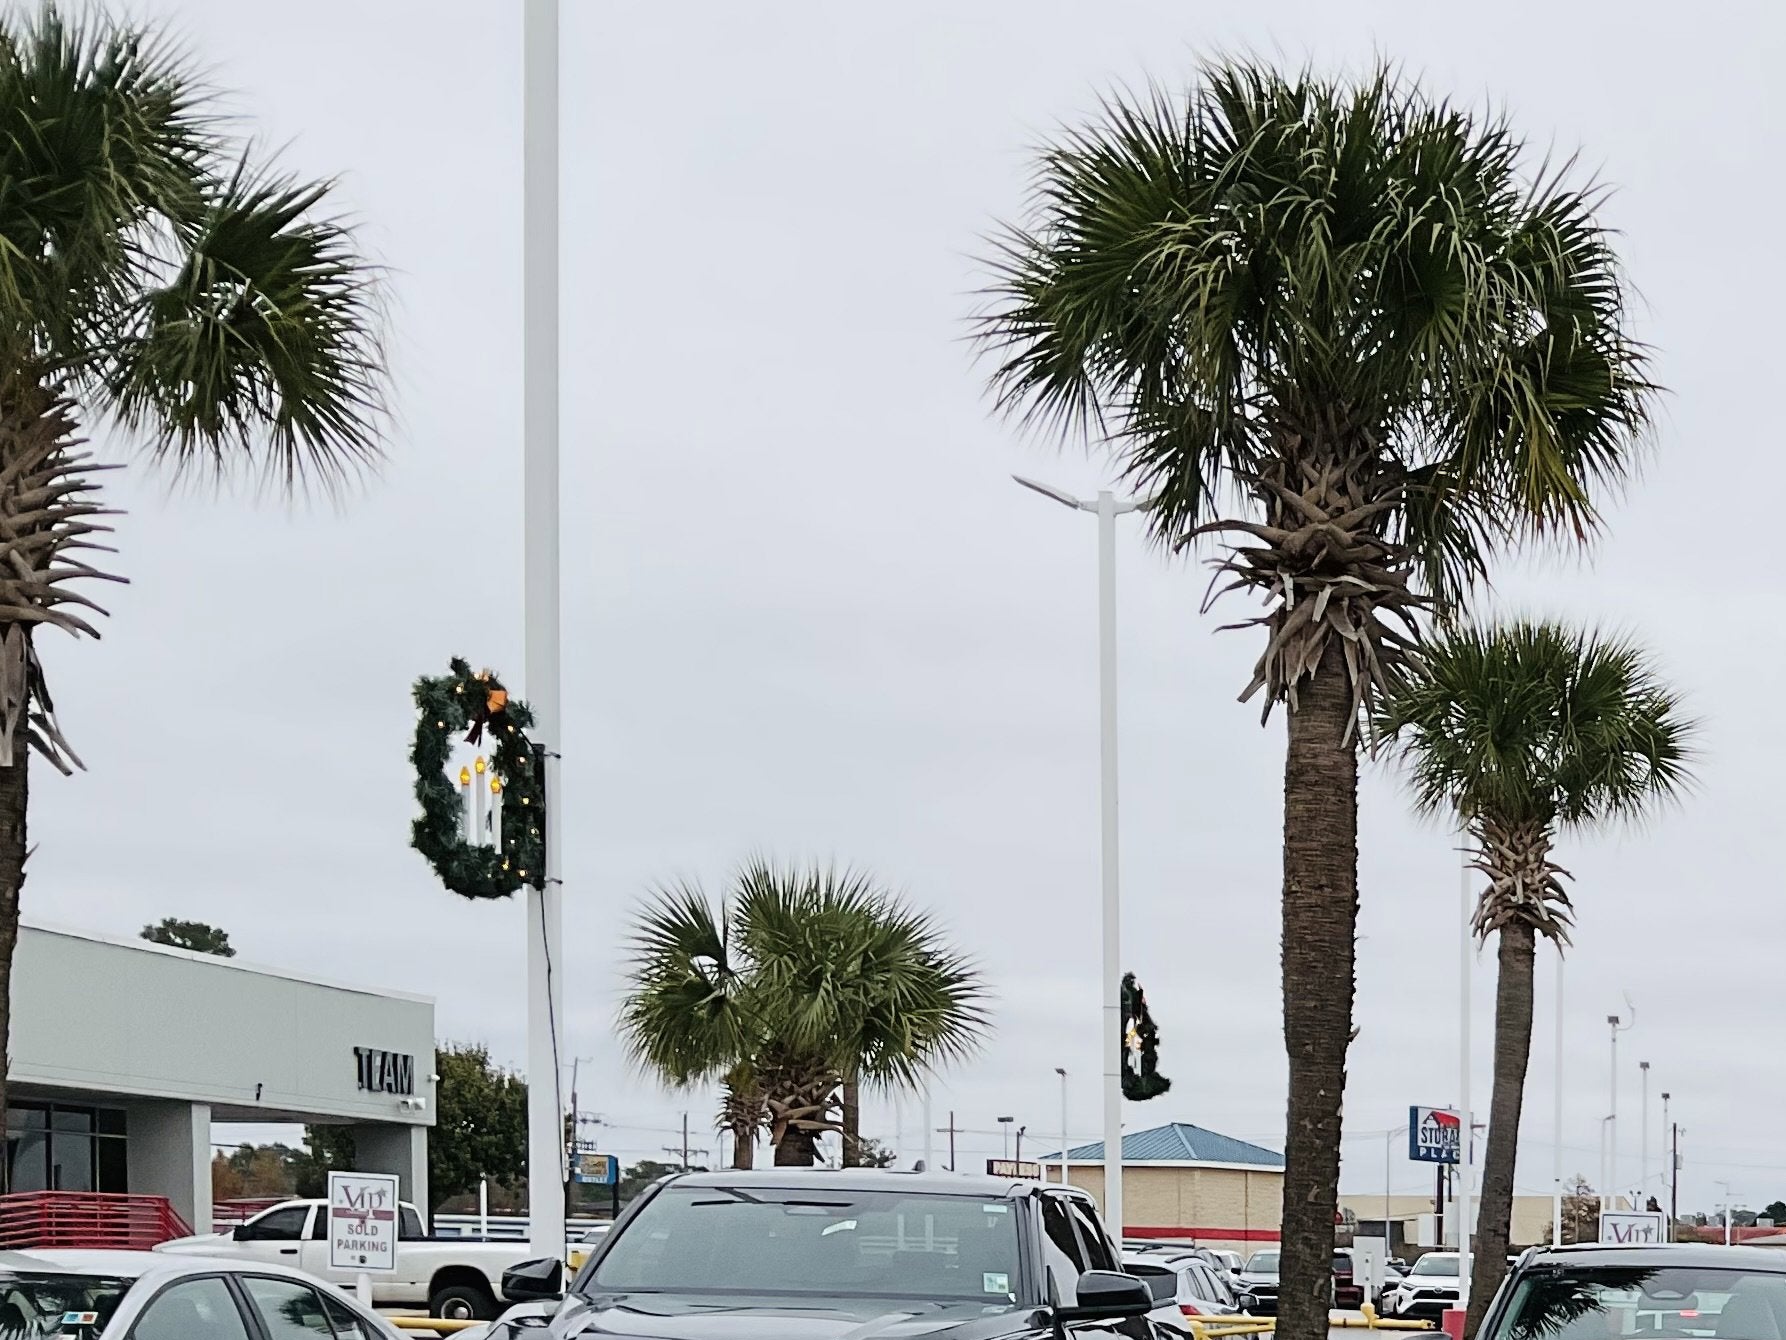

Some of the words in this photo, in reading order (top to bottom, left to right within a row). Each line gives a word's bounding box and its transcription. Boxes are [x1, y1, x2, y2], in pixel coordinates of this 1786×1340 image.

[354, 1046, 414, 1096] TEAM
[1420, 1147, 1460, 1160] PLAC
[347, 1223, 379, 1236] SOLD
[337, 1238, 388, 1253] PARKING
